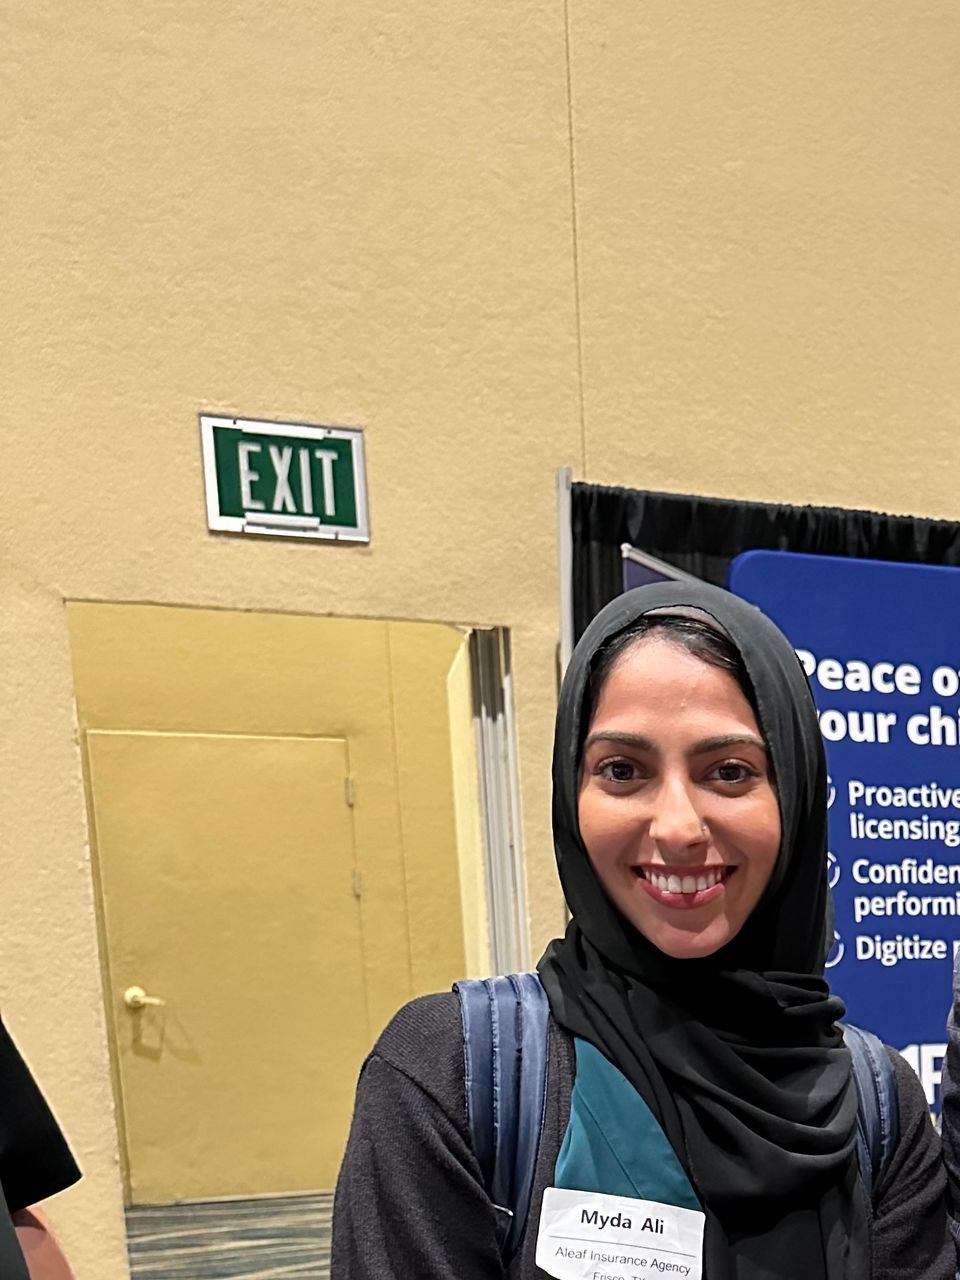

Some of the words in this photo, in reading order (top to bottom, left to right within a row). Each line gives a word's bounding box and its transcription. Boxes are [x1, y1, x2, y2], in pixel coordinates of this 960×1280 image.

[238, 441, 338, 516] EXIT
[794, 648, 922, 695] Peace
[814, 706, 897, 744] our
[850, 812, 960, 847] licensing
[856, 935, 947, 966] Digitize
[581, 1210, 632, 1230] Myda
[641, 1218, 665, 1235] Ali
[555, 1247, 588, 1260] Aleaf
[590, 1251, 648, 1268] Insurance
[650, 1258, 692, 1277] Agency
